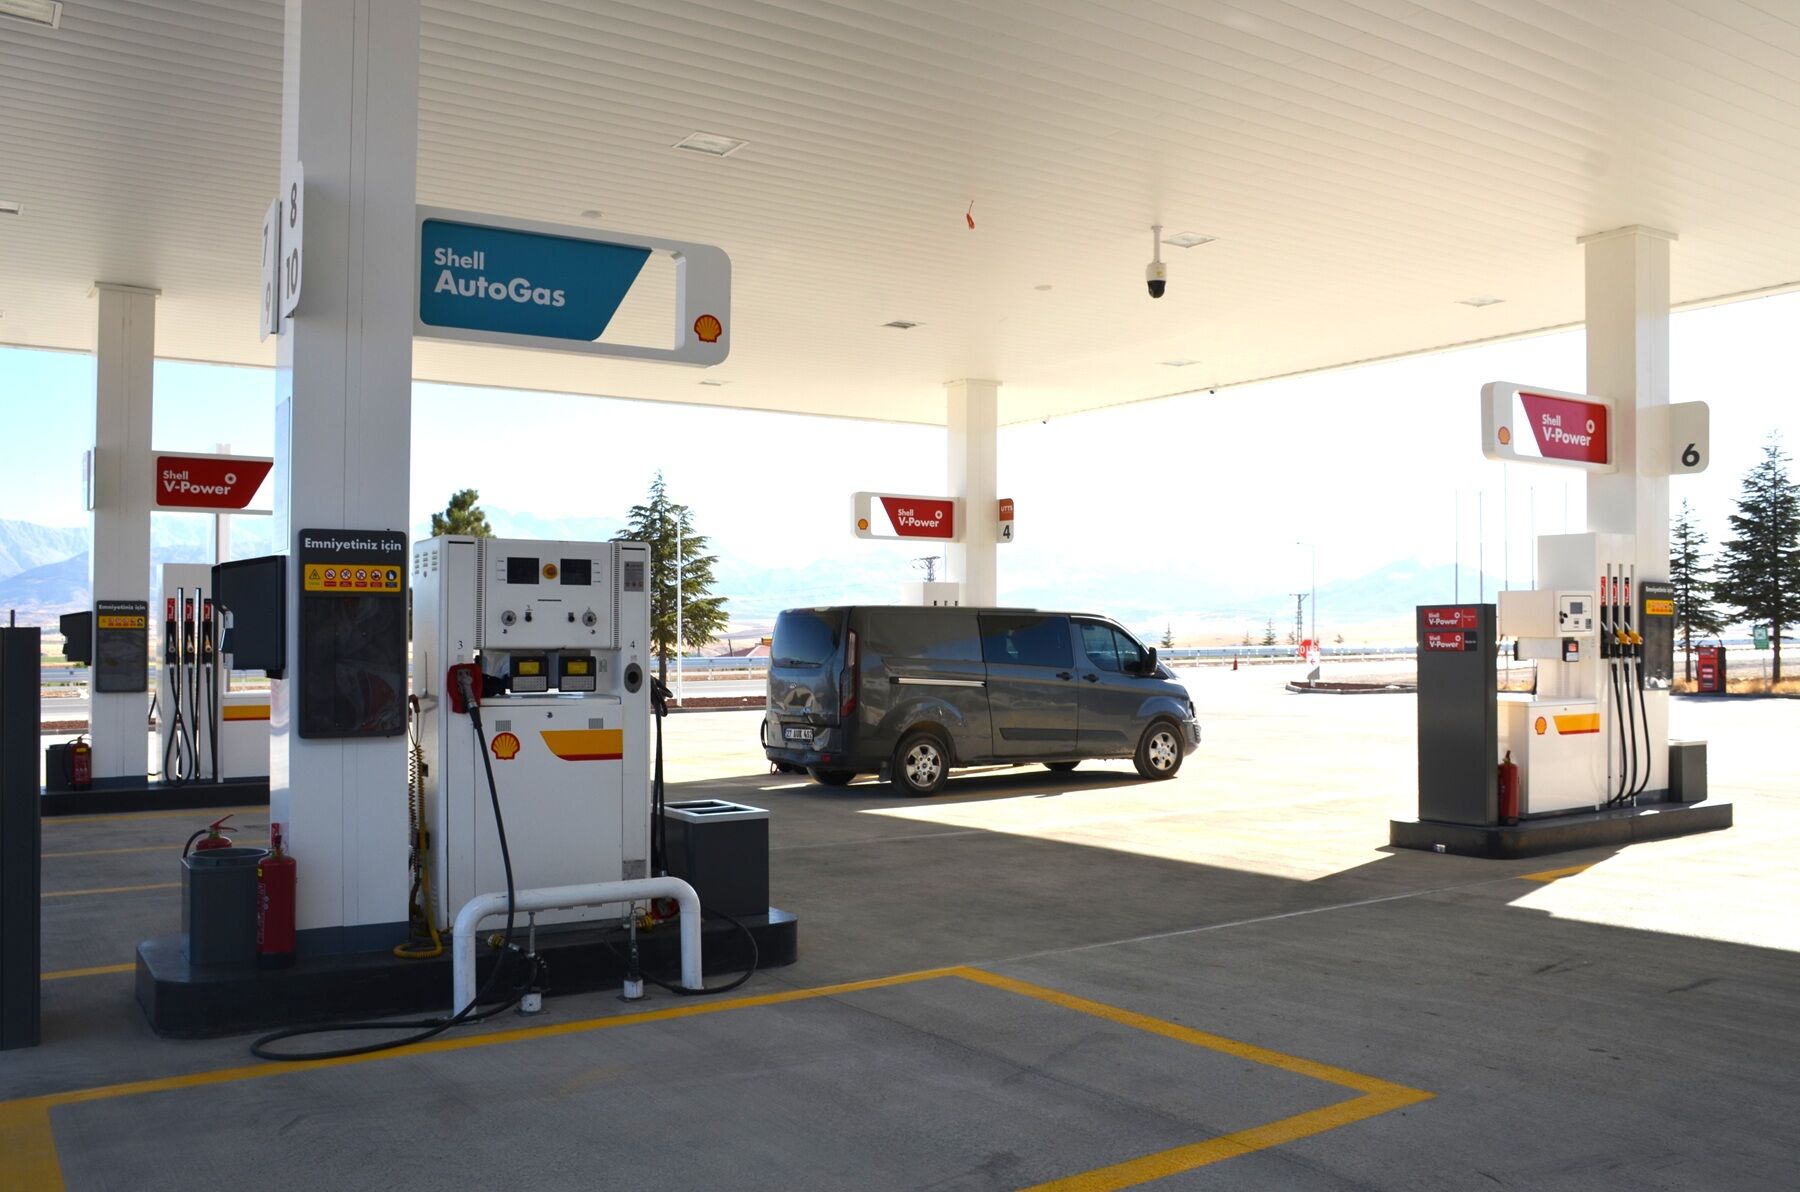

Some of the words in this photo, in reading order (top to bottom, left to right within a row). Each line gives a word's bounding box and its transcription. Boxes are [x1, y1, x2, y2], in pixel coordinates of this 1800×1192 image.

[290, 182, 297, 229] 8
[434, 247, 485, 270] Shell
[286, 247, 299, 300] 10
[434, 269, 566, 307] AutoGas
[1542, 414, 1561, 426] Shell
[1543, 427, 1592, 446] V-Power
[1681, 443, 1700, 467] 6
[163, 470, 189, 480] Shell
[163, 480, 231, 494] V-Power
[898, 509, 914, 517] Shell
[899, 516, 939, 528] V-Power
[1002, 524, 1011, 539] 4
[304, 537, 378, 552] Emniyetiniz
[381, 540, 402, 553] için
[457, 640, 464, 650] 3
[630, 640, 636, 649] 4
